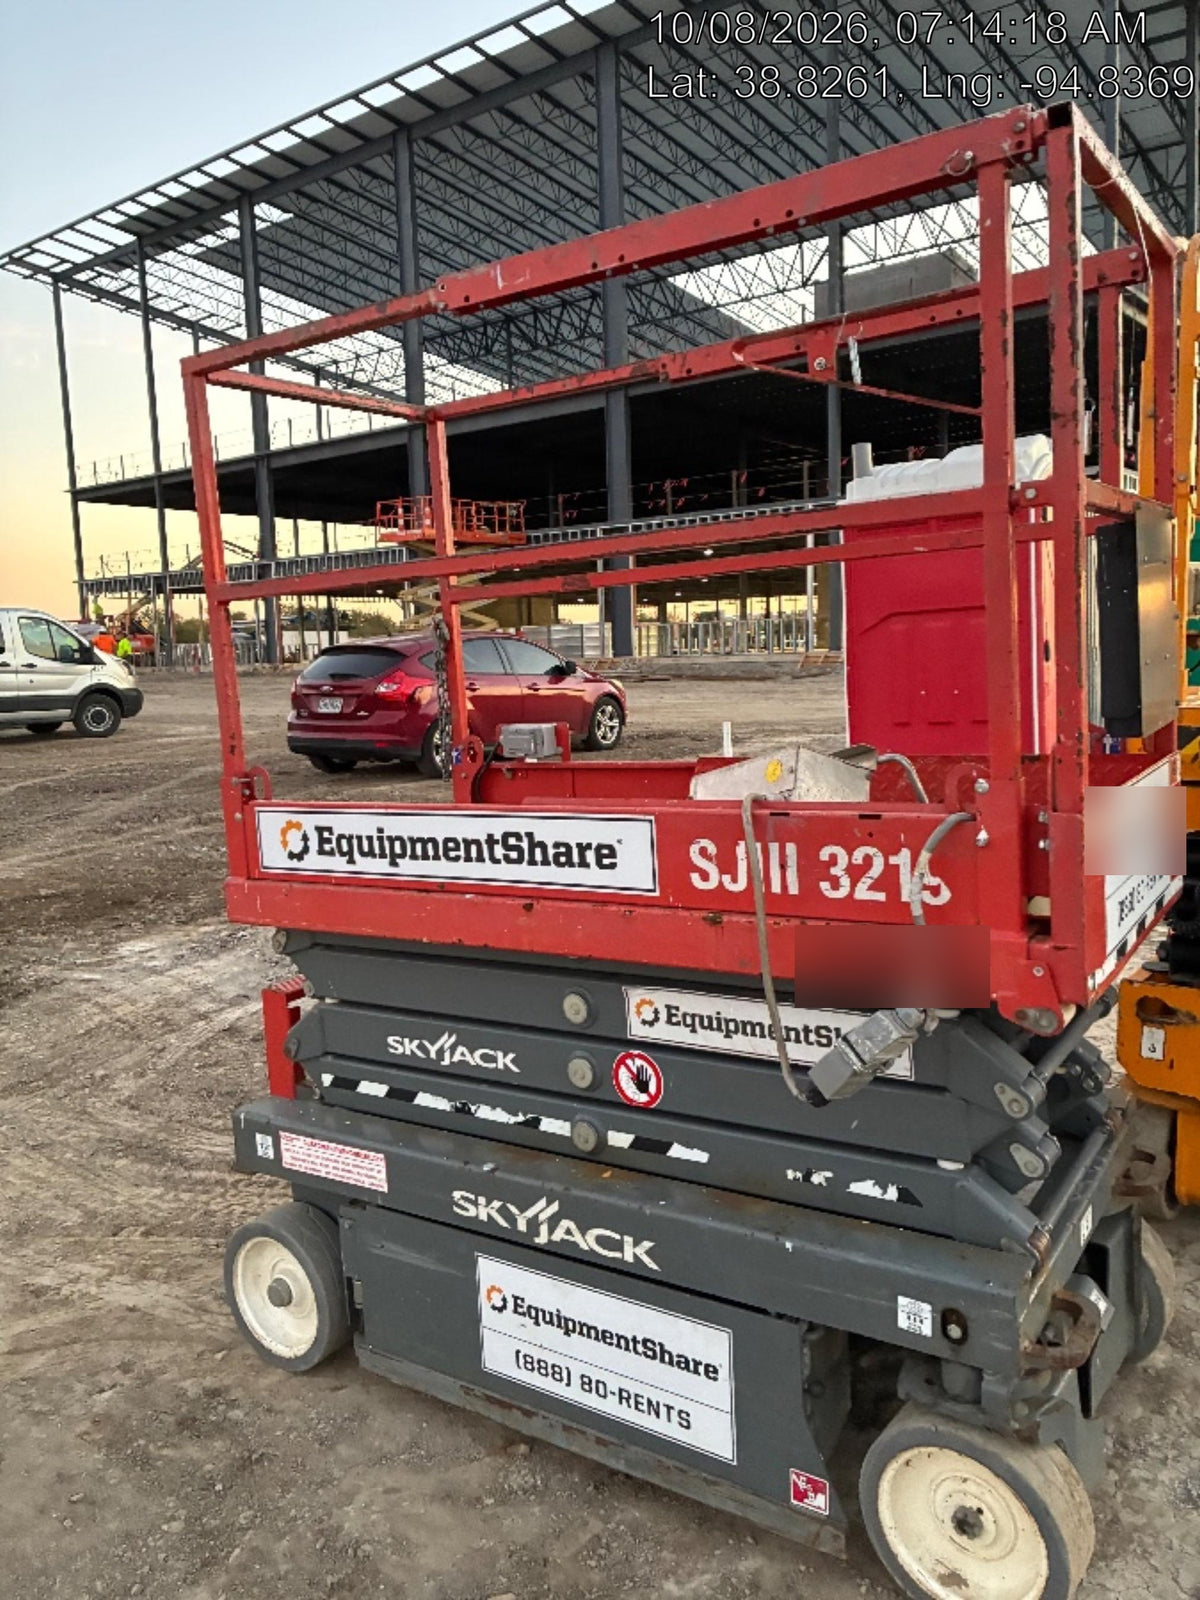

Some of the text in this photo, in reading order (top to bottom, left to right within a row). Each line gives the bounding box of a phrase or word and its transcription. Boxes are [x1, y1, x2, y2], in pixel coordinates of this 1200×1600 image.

[314, 825, 618, 870] EquipmentShare
[386, 1030, 520, 1073] SKYJACK
[665, 1004, 842, 1048] EquipmntS
[452, 1190, 662, 1272] SKYJACK
[511, 1294, 719, 1382] EquipmentShare
[515, 1348, 692, 1430] (888) 80-RENTS
